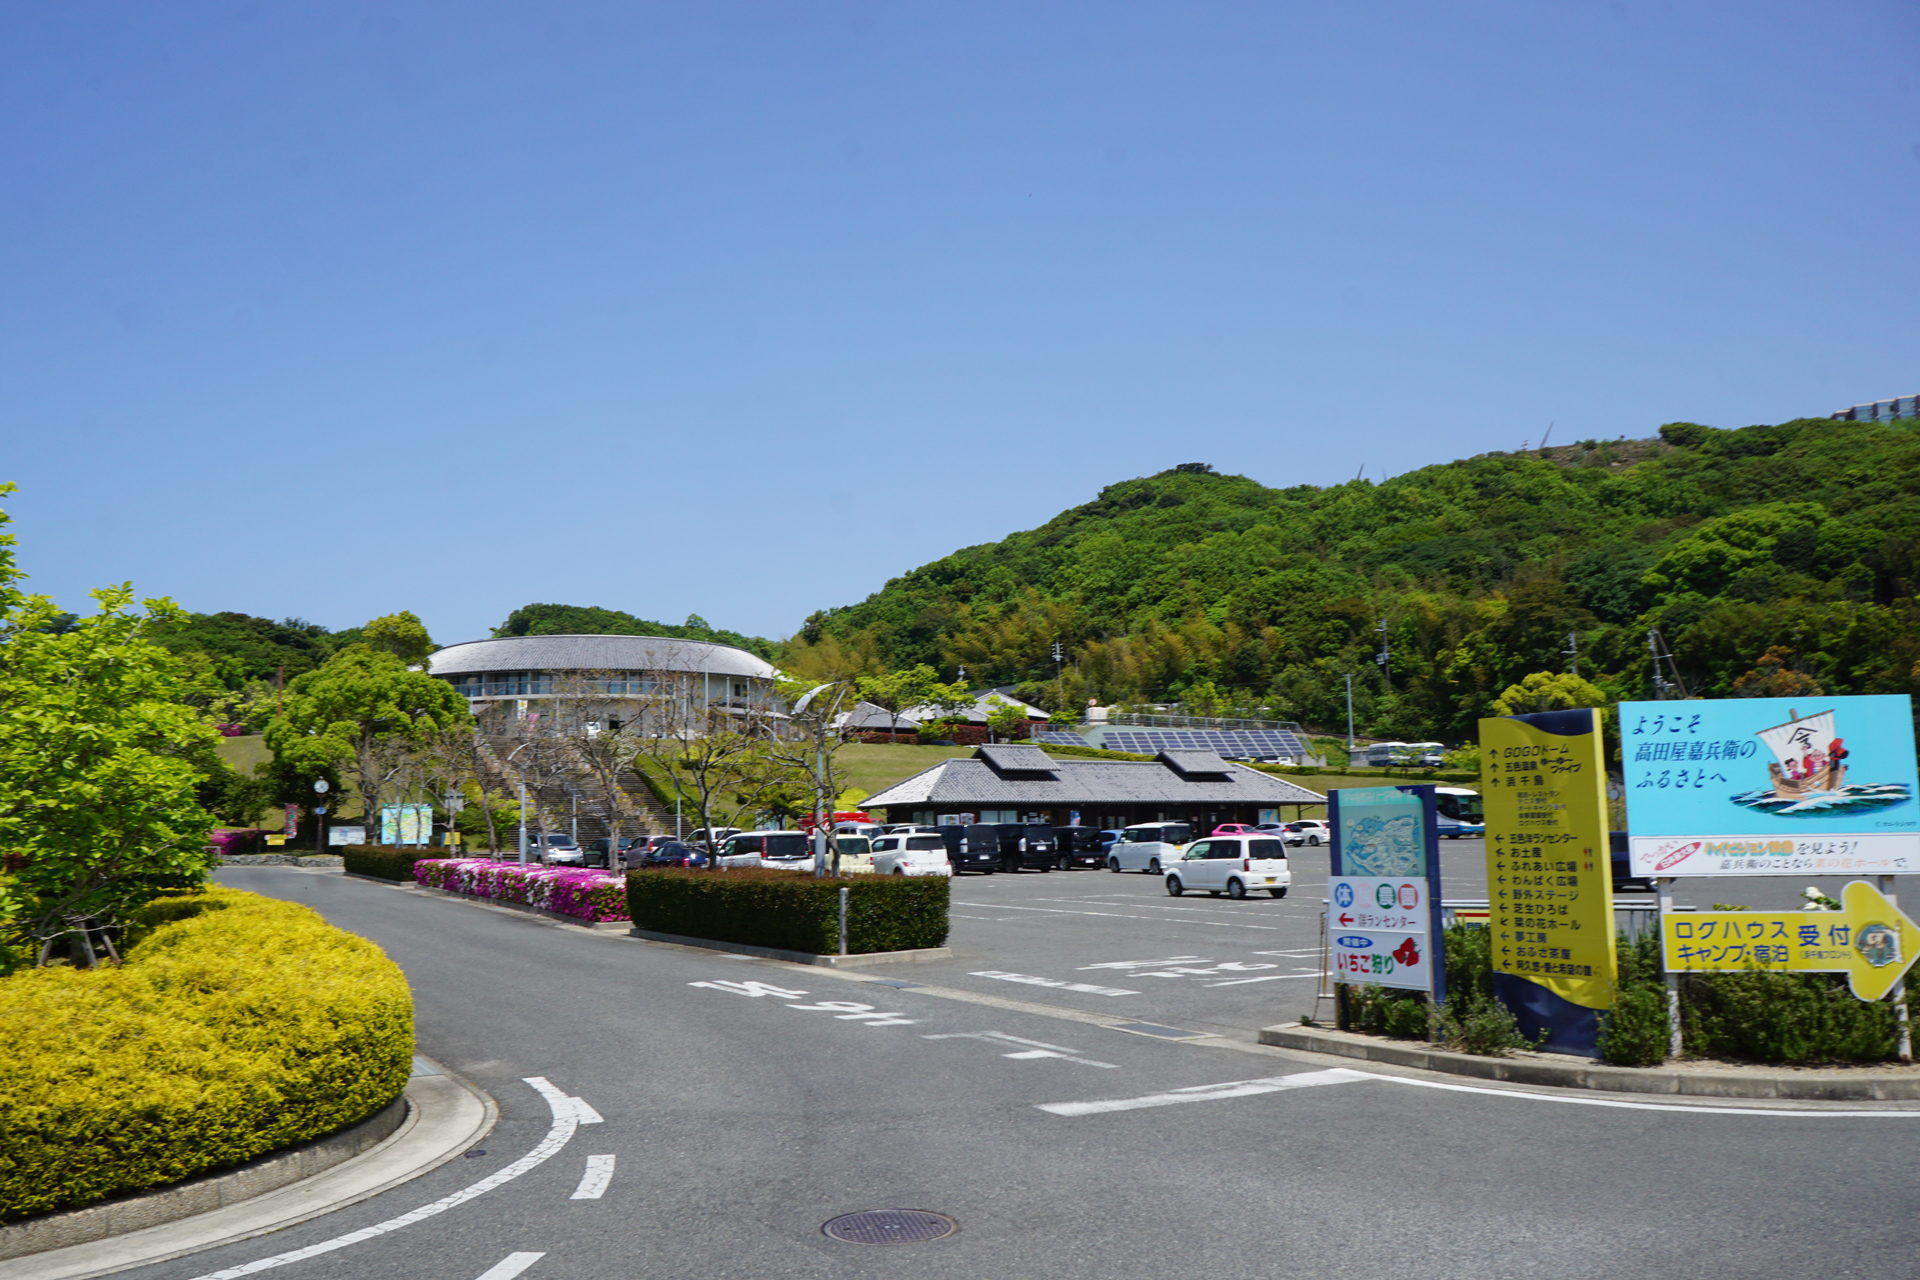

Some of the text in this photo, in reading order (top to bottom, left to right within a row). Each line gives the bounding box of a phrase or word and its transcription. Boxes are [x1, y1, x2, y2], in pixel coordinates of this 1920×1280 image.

[1632, 714, 1701, 735] ようこそ
[1503, 743, 1570, 758] GOGOドーム
[1634, 739, 1757, 762] 高田屋嘉兵衛の
[1636, 768, 1727, 788] ふるさとへ
[1509, 833, 1578, 844] 五色洋ランセンター
[1510, 847, 1542, 858] お土産
[1511, 861, 1577, 872] ふれあい広場
[1512, 889, 1579, 901] 野外ステージ
[1513, 903, 1568, 915] 芝生ひろば
[1358, 913, 1416, 928] 洋ランセンター
[1514, 917, 1581, 930] 菜の花ホール
[1676, 921, 1789, 940] ログハウス
[1798, 924, 1851, 947] 受付
[1677, 943, 1789, 963] キャンプ・宿泊
[1337, 952, 1394, 975] いちご狩り
